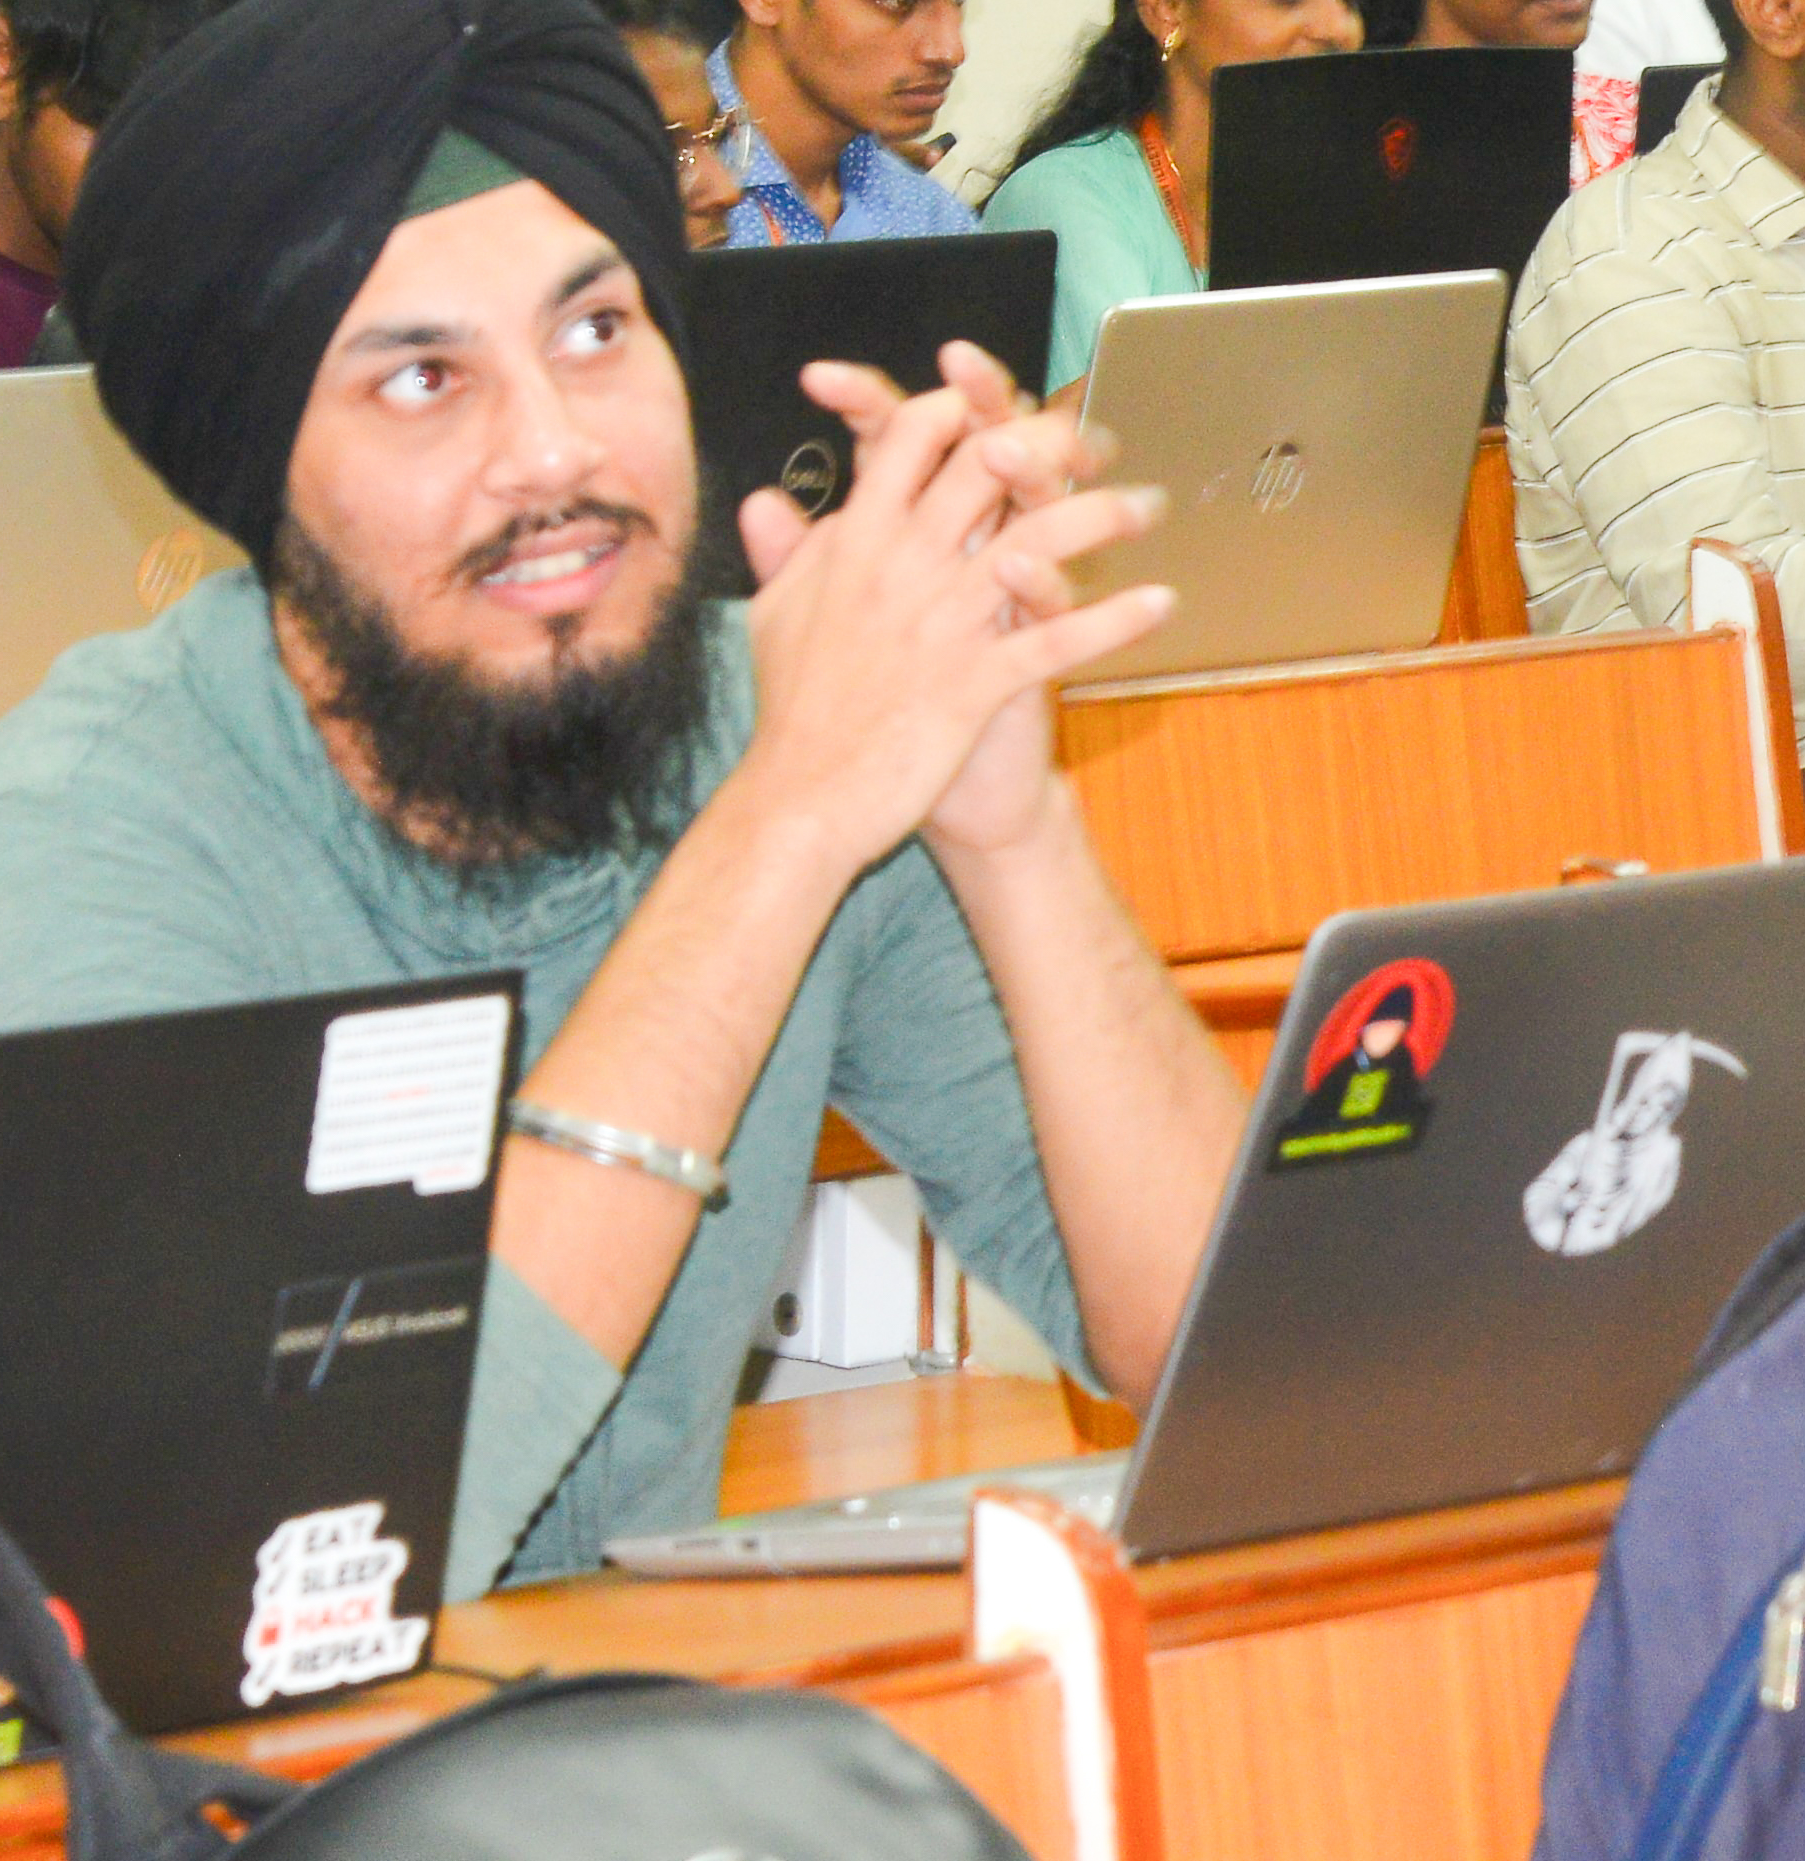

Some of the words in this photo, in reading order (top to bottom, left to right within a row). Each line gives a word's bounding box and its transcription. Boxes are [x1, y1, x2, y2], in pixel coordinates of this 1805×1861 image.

[303, 1513, 367, 1555] EAT
[301, 1553, 390, 1595] SLEEP
[292, 1623, 413, 1673] REPEAT
